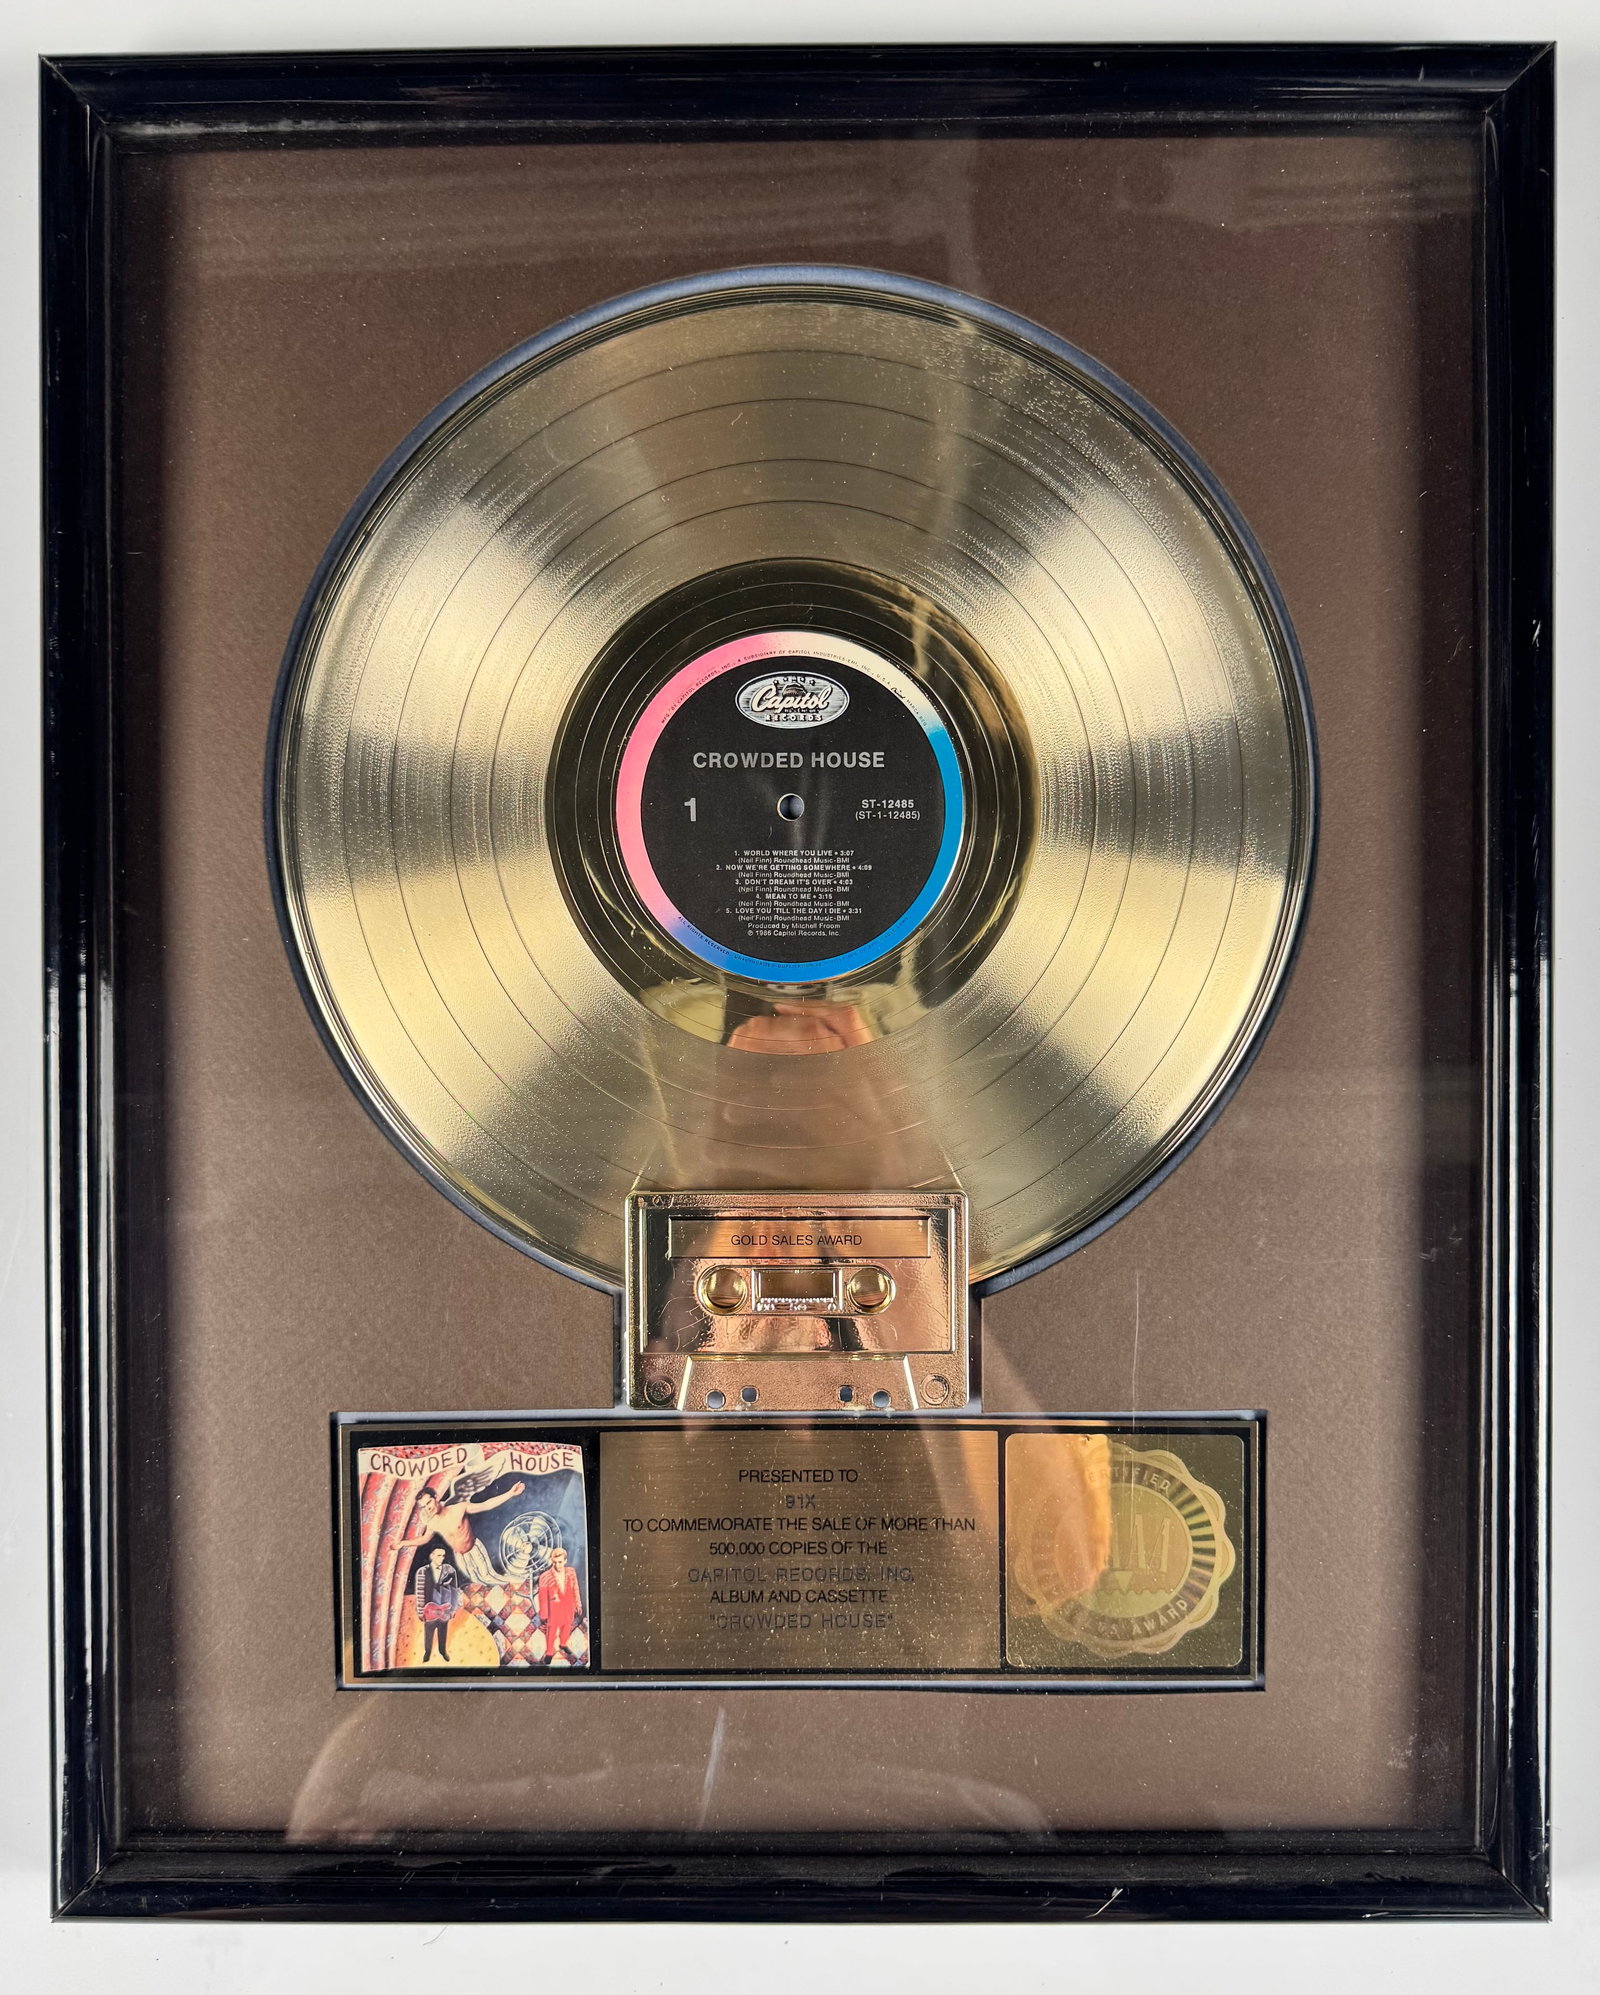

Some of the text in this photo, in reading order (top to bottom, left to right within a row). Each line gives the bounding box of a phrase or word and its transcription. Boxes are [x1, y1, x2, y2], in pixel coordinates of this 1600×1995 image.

[750, 683, 833, 714] Capitol
[765, 714, 823, 722] RECORDS
[692, 752, 885, 769] CROWDED HOUSE
[684, 798, 697, 822] 1
[861, 799, 914, 810] ST-12485
[855, 810, 921, 821] (ST-1-12485)
[730, 1234, 863, 1246] GOLD SALES AWARD
[370, 1448, 575, 1478] CROWDED HOUSE
[738, 1469, 858, 1483] PRESENTED TO
[623, 1517, 976, 1532] TO COMMEMORATE THE SALE OF MORE THAN
[709, 1541, 888, 1556] 500,000 COPIES OF THE
[688, 1568, 766, 1582] CAPITOL
[880, 1567, 915, 1583] INC.
[710, 1590, 889, 1604] ALBUM AND CASSETTE
[709, 1614, 894, 1630] "CROWDED HOUSE"
[1132, 1599, 1188, 1635] AWARD
